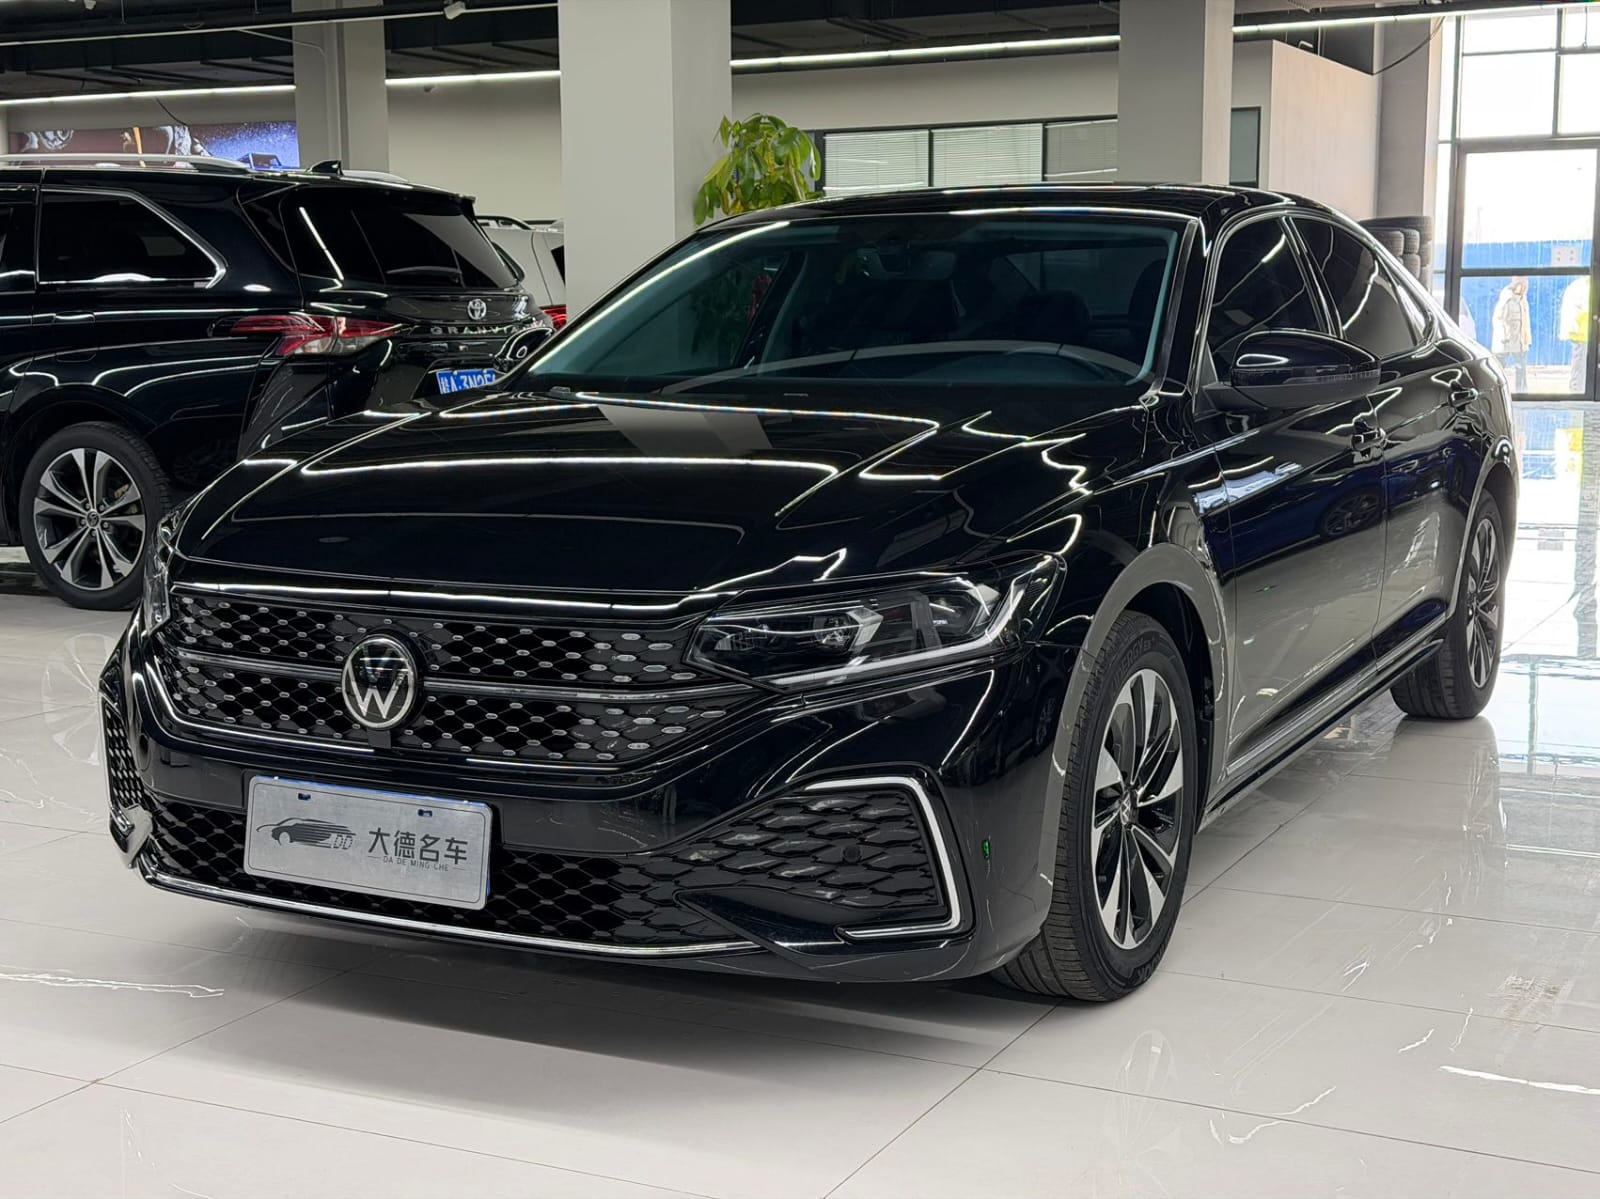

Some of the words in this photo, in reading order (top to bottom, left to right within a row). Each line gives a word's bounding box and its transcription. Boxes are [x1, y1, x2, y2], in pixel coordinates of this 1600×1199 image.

[368, 828, 468, 865] 大德名车
[383, 855, 394, 864] DA
[396, 858, 407, 866] DE
[411, 860, 430, 869] MING
[434, 863, 449, 872] CHE
